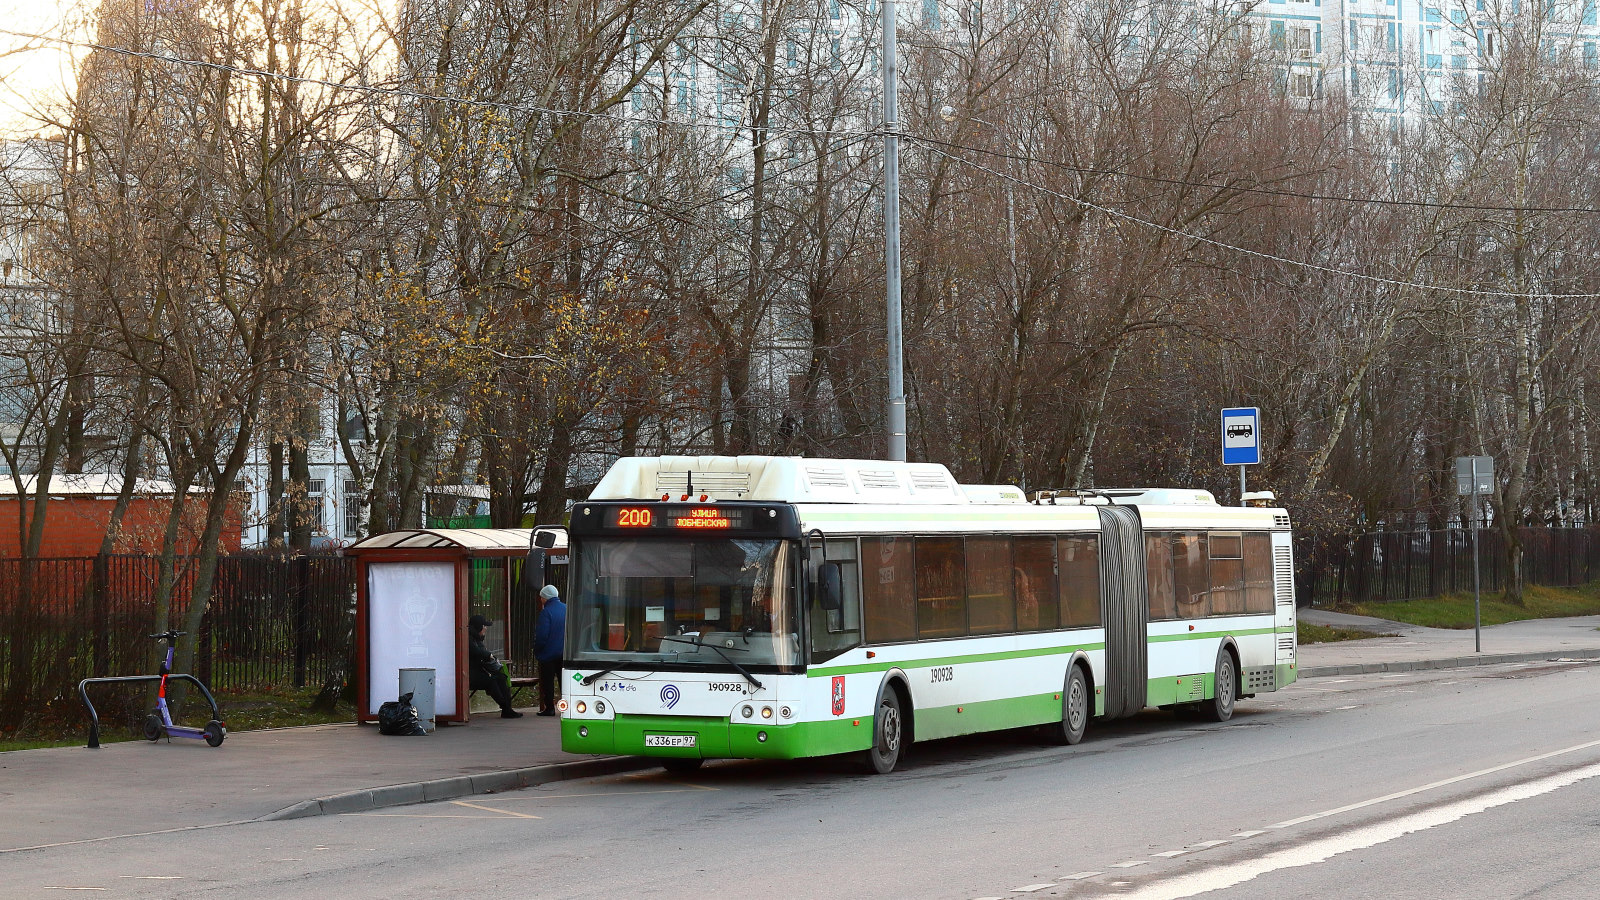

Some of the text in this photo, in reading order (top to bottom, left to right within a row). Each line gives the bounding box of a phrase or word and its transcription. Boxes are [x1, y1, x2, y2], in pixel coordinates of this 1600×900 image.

[619, 508, 651, 526] 200
[691, 509, 718, 518] УЛИЦА
[676, 518, 727, 527] ЛОБНЕНСКАЯ
[931, 667, 953, 683] 190928
[708, 682, 742, 691] 190928
